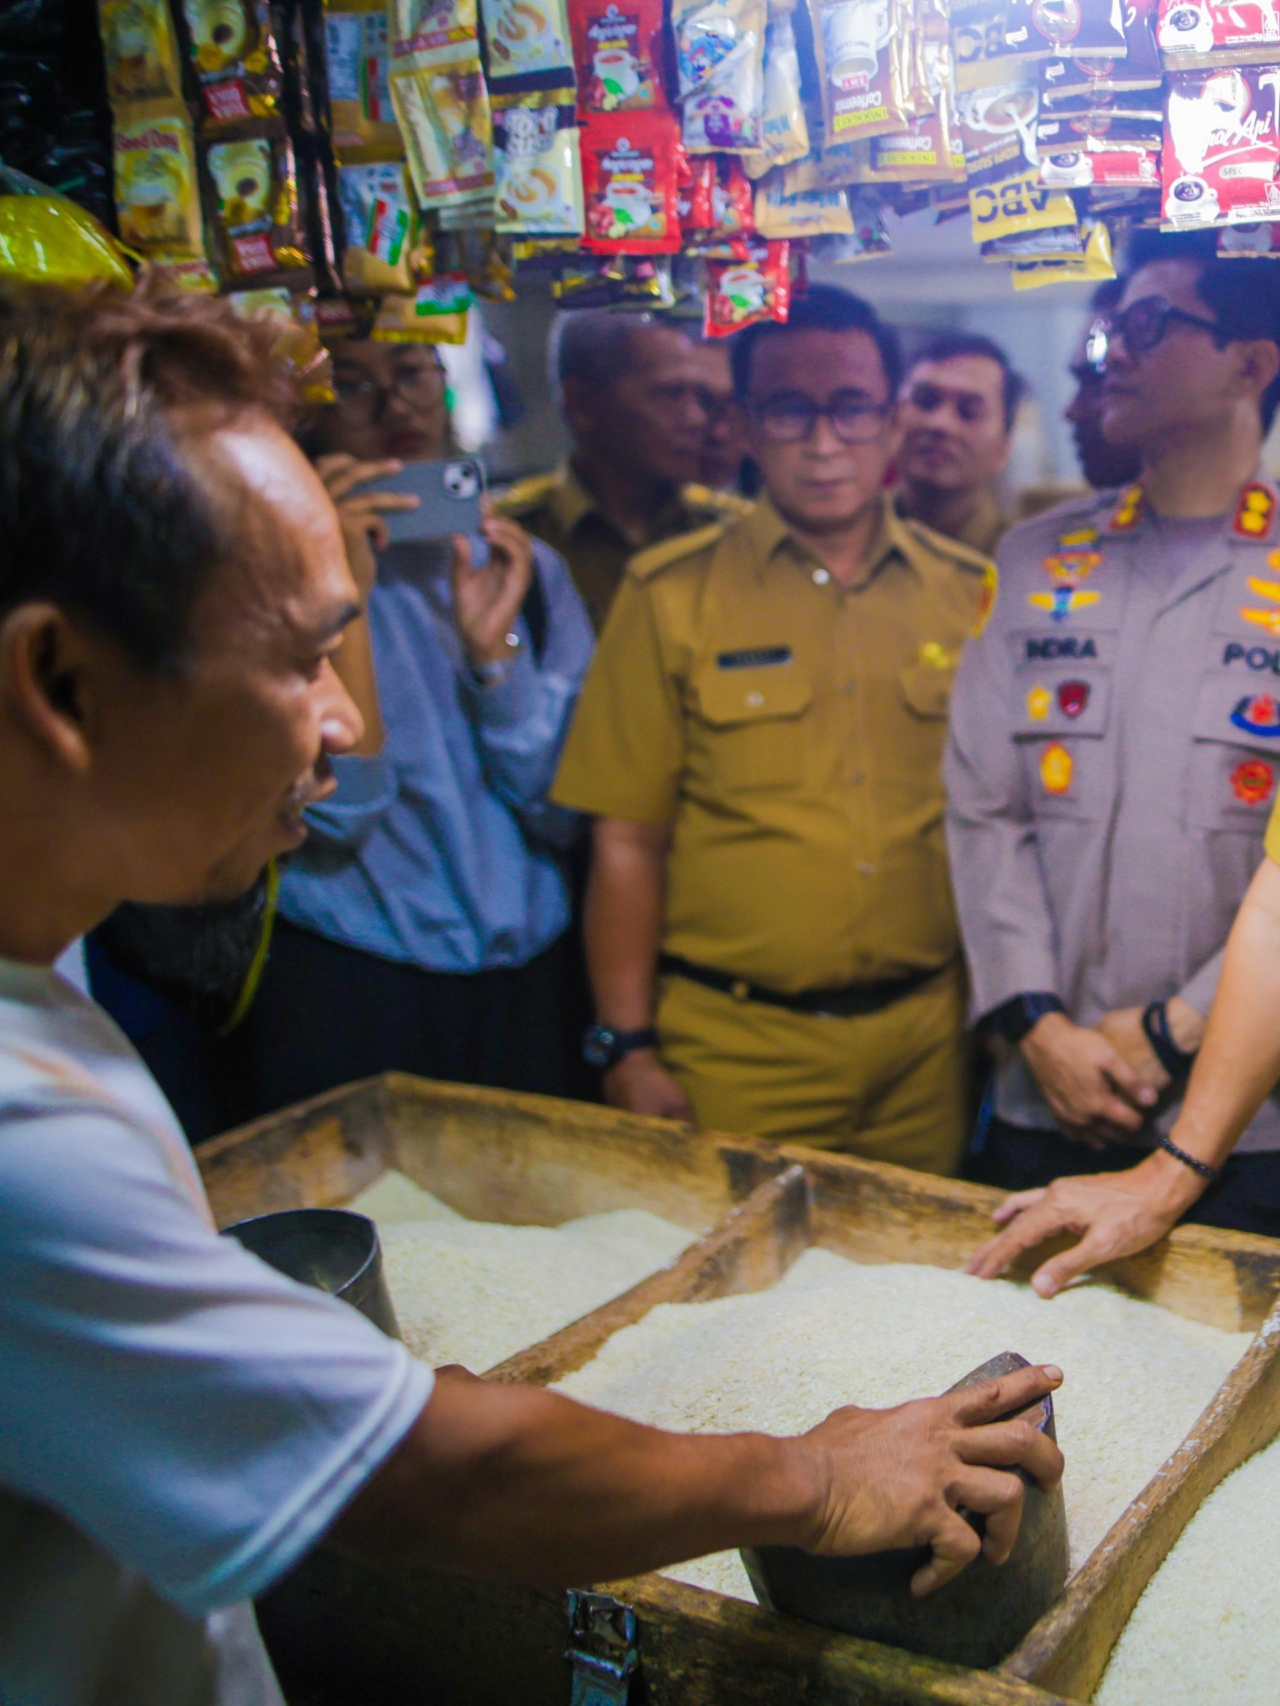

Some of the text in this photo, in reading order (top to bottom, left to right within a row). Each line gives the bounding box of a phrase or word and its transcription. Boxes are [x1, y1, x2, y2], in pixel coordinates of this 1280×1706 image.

[957, 23, 1004, 63] BC
[835, 91, 882, 112] Coffeemix
[834, 108, 888, 131] INDOCAFE
[1233, 111, 1272, 145] Api
[975, 180, 1050, 223] ABC
